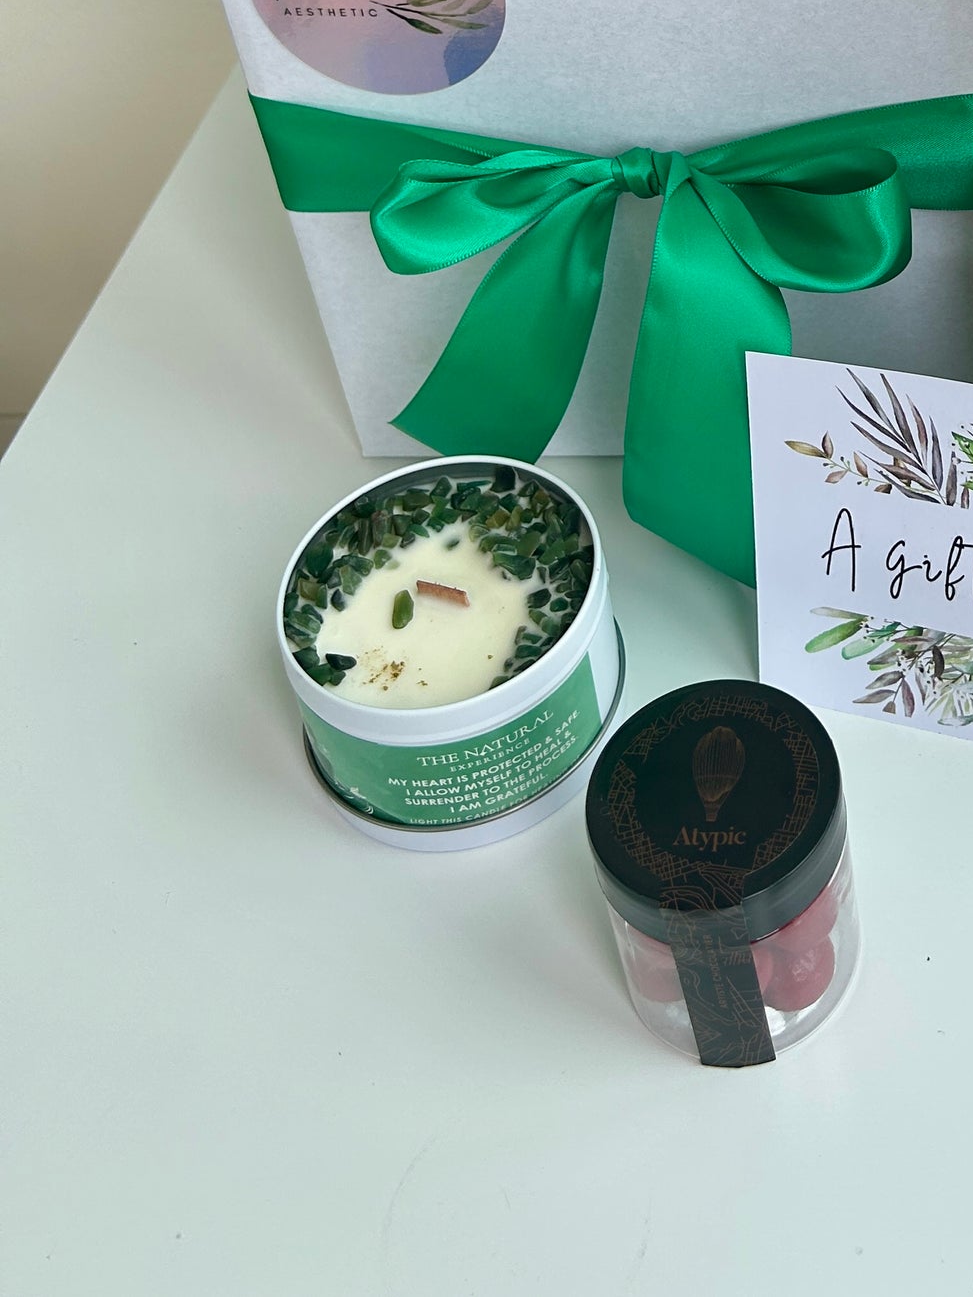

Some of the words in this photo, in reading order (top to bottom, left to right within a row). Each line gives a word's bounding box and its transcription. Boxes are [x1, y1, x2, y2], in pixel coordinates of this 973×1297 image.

[284, 7, 378, 18] AESTHETIC
[821, 508, 861, 592] A
[416, 752, 459, 767] THE
[464, 710, 554, 760] NATURAL
[449, 737, 530, 773] EXPERIENCE
[388, 777, 407, 787] MY
[412, 777, 453, 787] HEART
[457, 774, 469, 784] IS
[472, 742, 542, 780] PROTECTED
[545, 735, 553, 745] &
[414, 786, 460, 797] ALLOW
[464, 769, 512, 792] MYSELF
[515, 760, 532, 773] TO
[535, 738, 562, 762] HEAL
[564, 730, 572, 739] &
[405, 792, 479, 806] SURRENDER
[482, 785, 500, 797] TO
[503, 773, 526, 788] THE
[459, 801, 482, 812] AM
[485, 773, 548, 805] GRATEFUL.
[410, 817, 438, 825] LIGHT
[672, 826, 747, 853] Atypic
